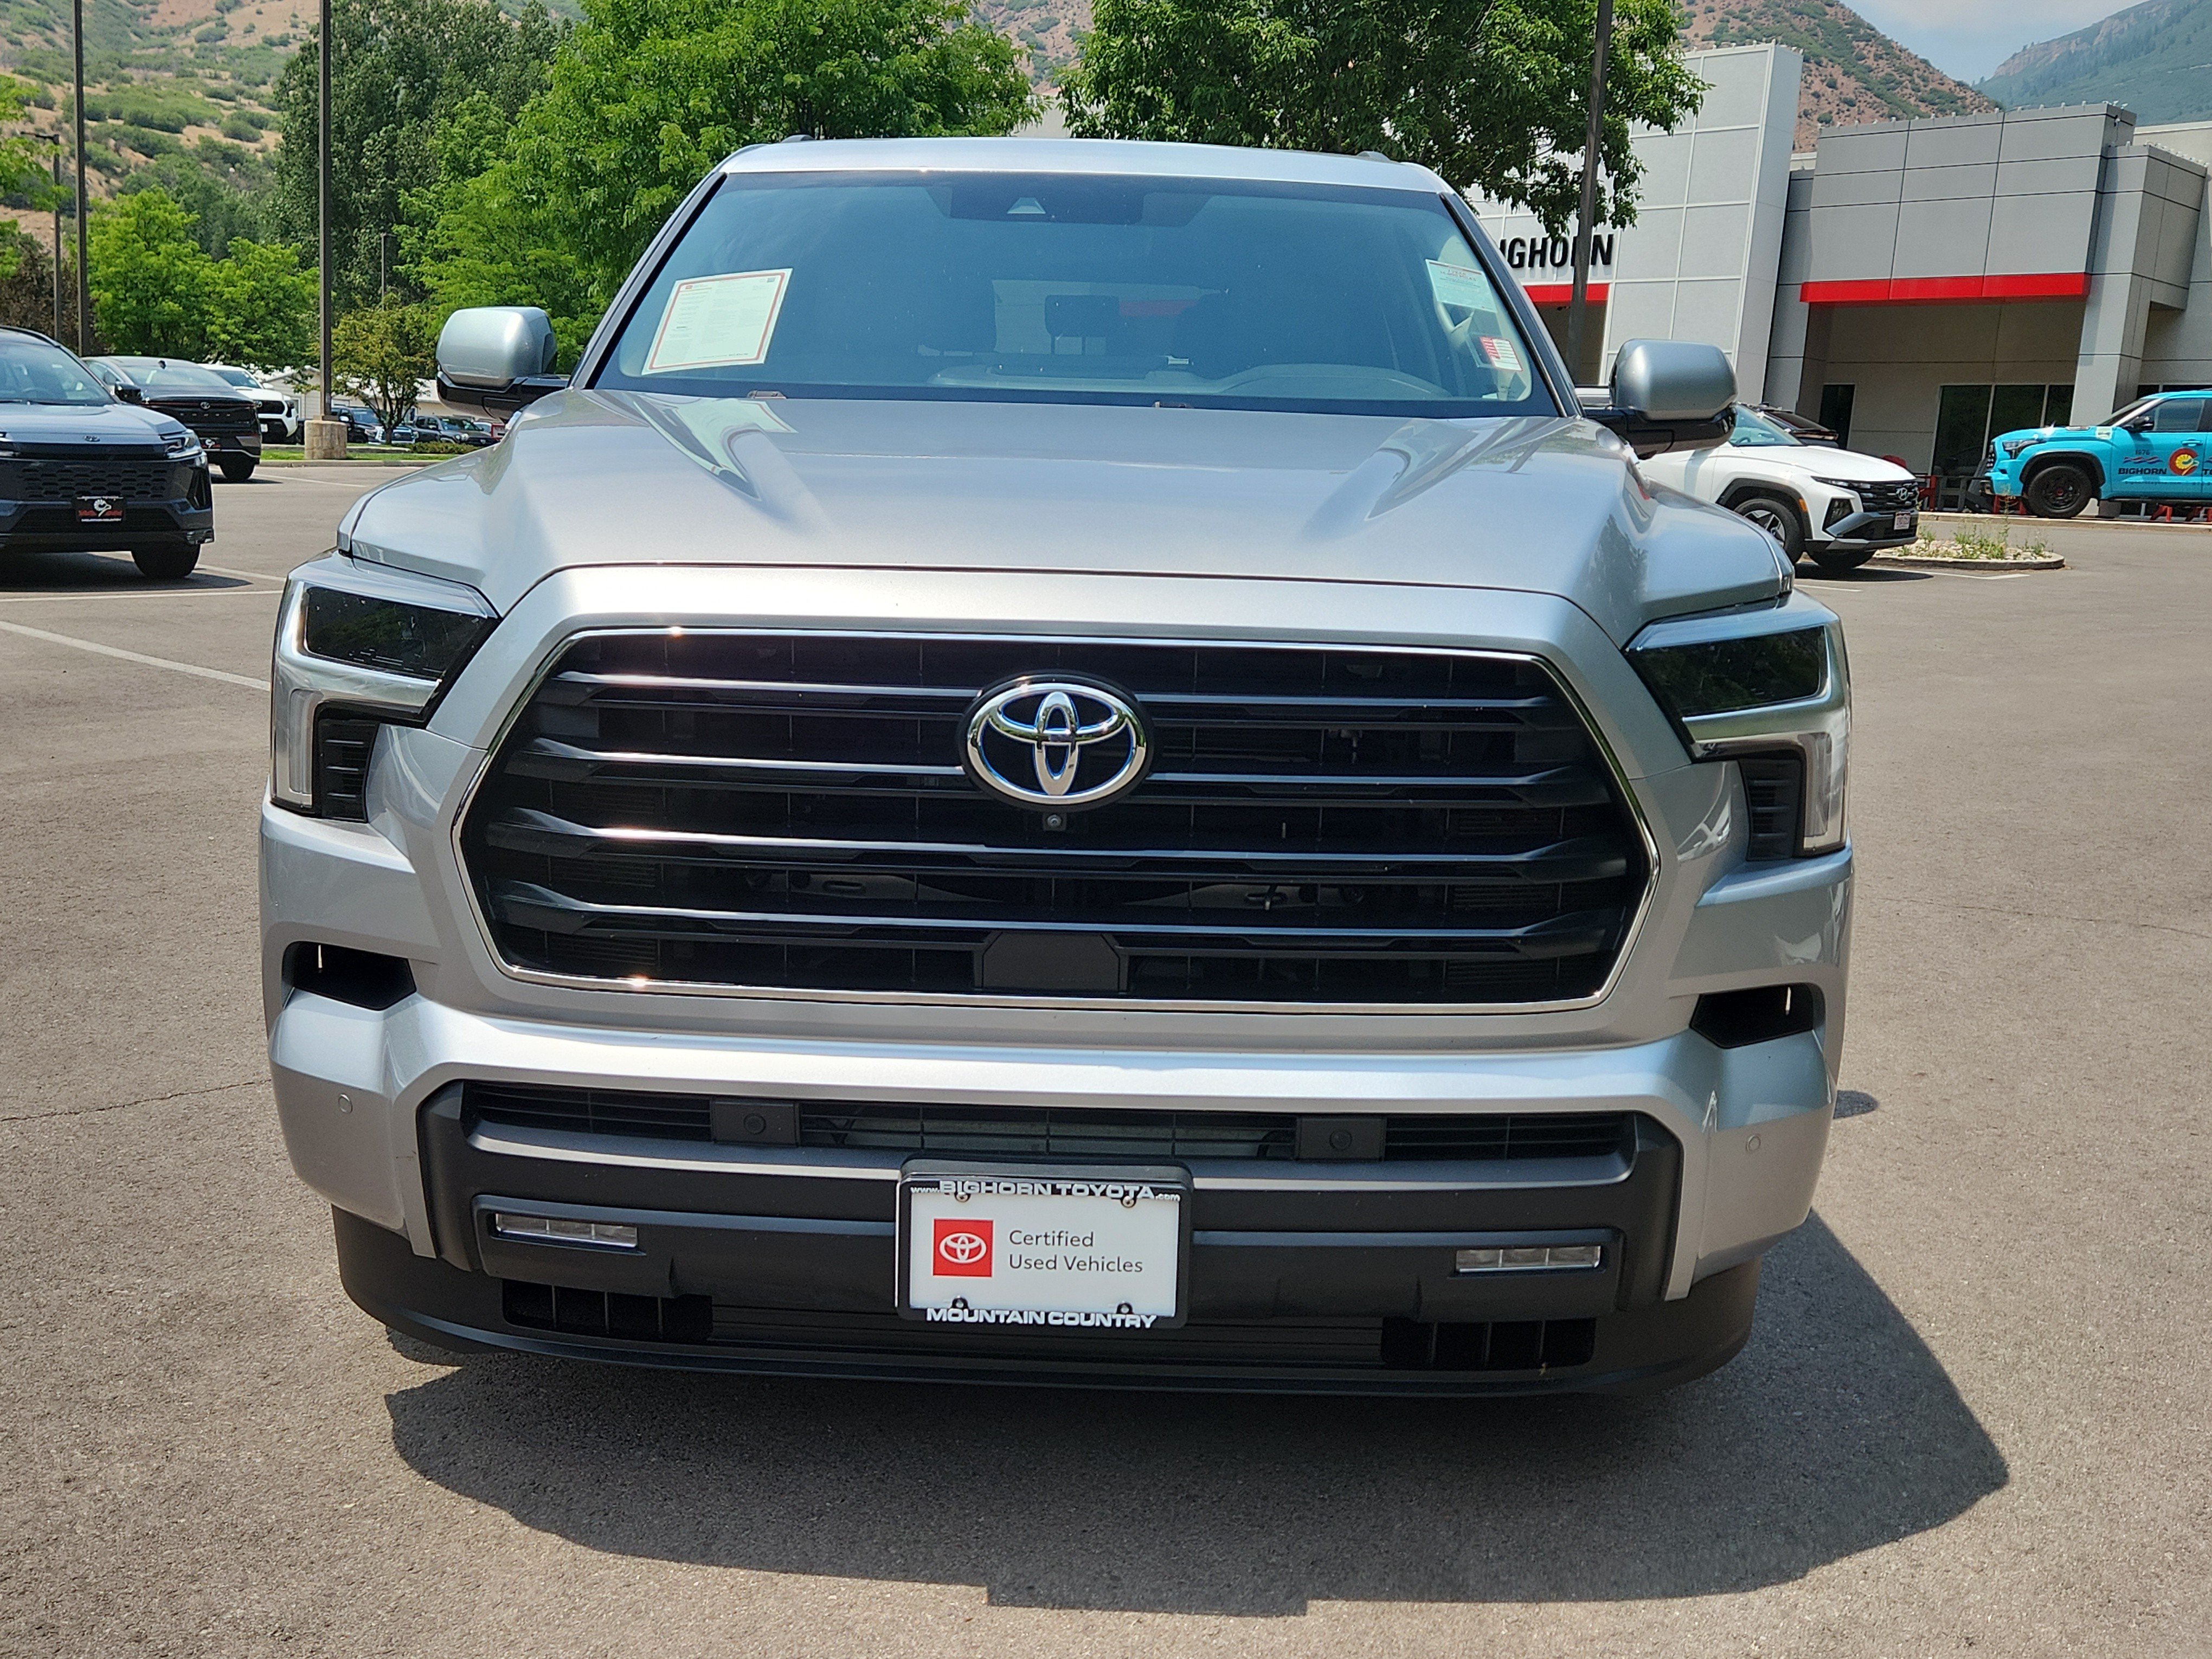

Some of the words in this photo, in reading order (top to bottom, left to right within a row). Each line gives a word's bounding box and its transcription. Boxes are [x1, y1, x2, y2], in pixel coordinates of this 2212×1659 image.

[1009, 1229, 1094, 1247] Certified
[1009, 1253, 1057, 1270] Used
[1063, 1255, 1143, 1272] Vehicles
[926, 1307, 1045, 1324] MOUNTAIN
[1047, 1311, 1157, 1328] COUNTRY
